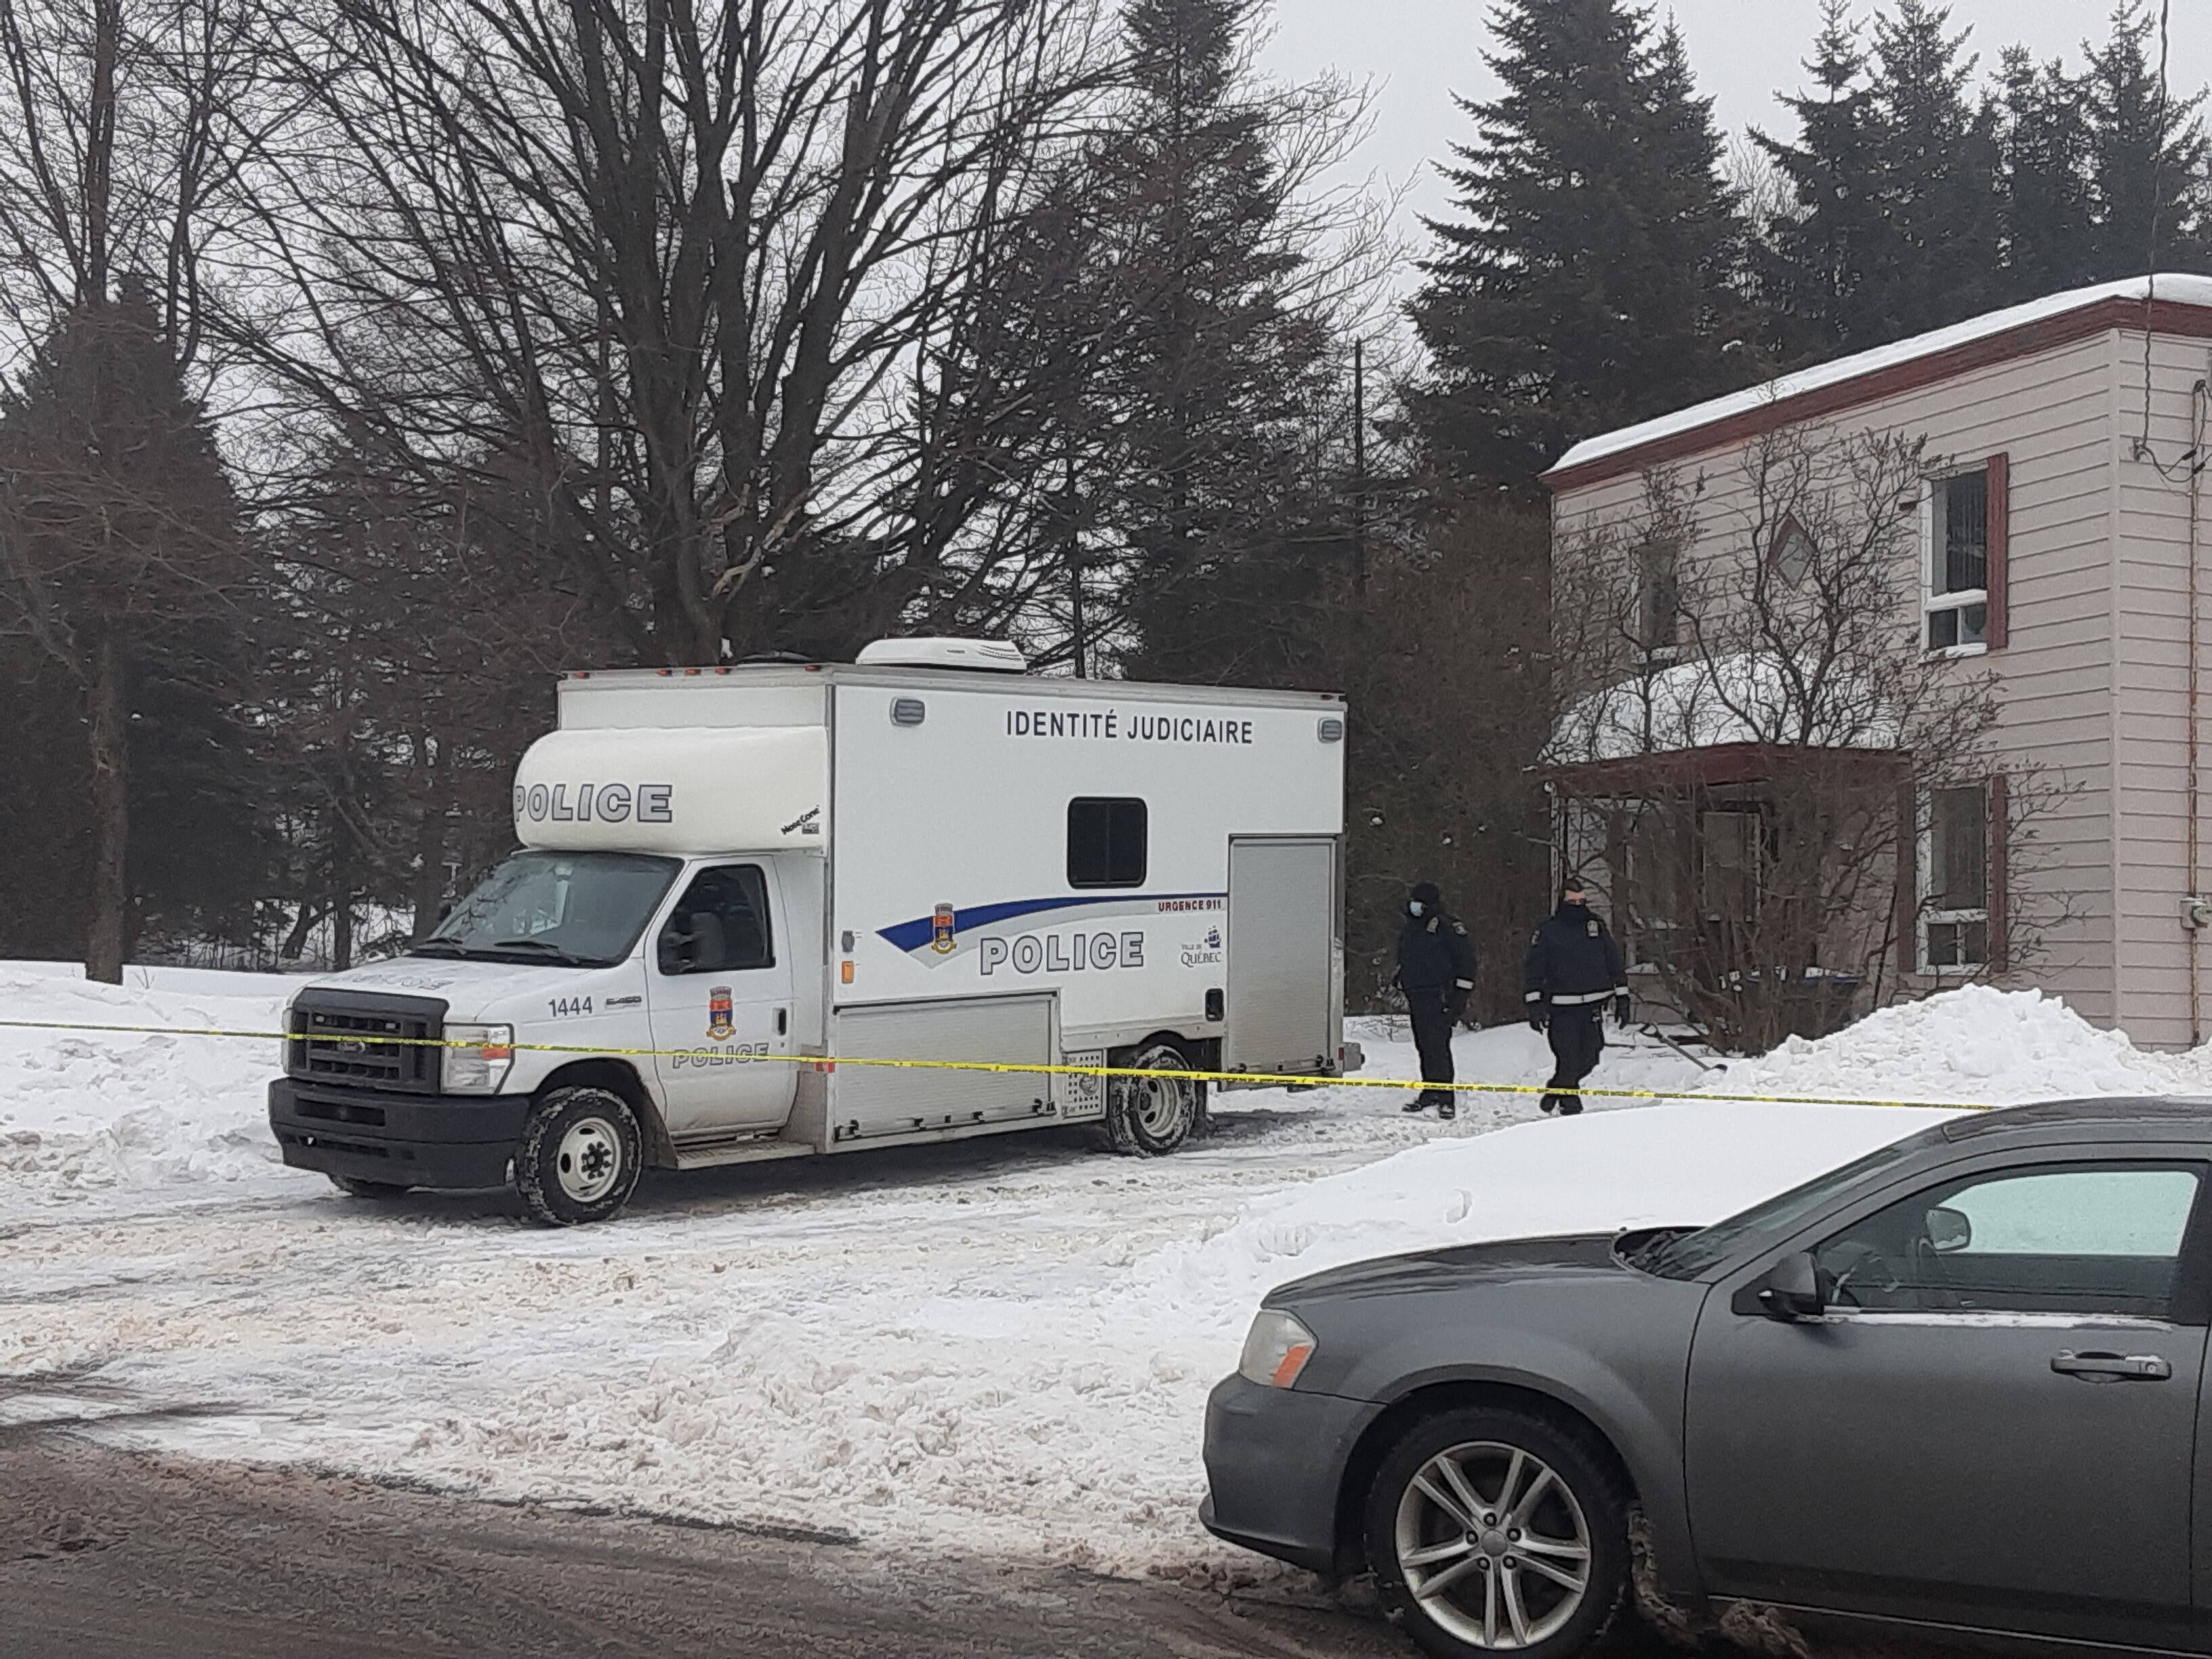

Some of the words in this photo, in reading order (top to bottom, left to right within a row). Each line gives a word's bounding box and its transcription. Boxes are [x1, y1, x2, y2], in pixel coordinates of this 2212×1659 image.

[1007, 709, 1118, 739] IDENTITÉ
[1127, 716, 1253, 744] JUDICIAIRE
[1158, 900, 1204, 912] URGENCE
[1206, 899, 1221, 909] 911
[980, 931, 1144, 976] POLICE
[1181, 950, 1222, 968] QUÉBEC
[548, 996, 592, 1017] 1444
[672, 1042, 769, 1069] POLICE
